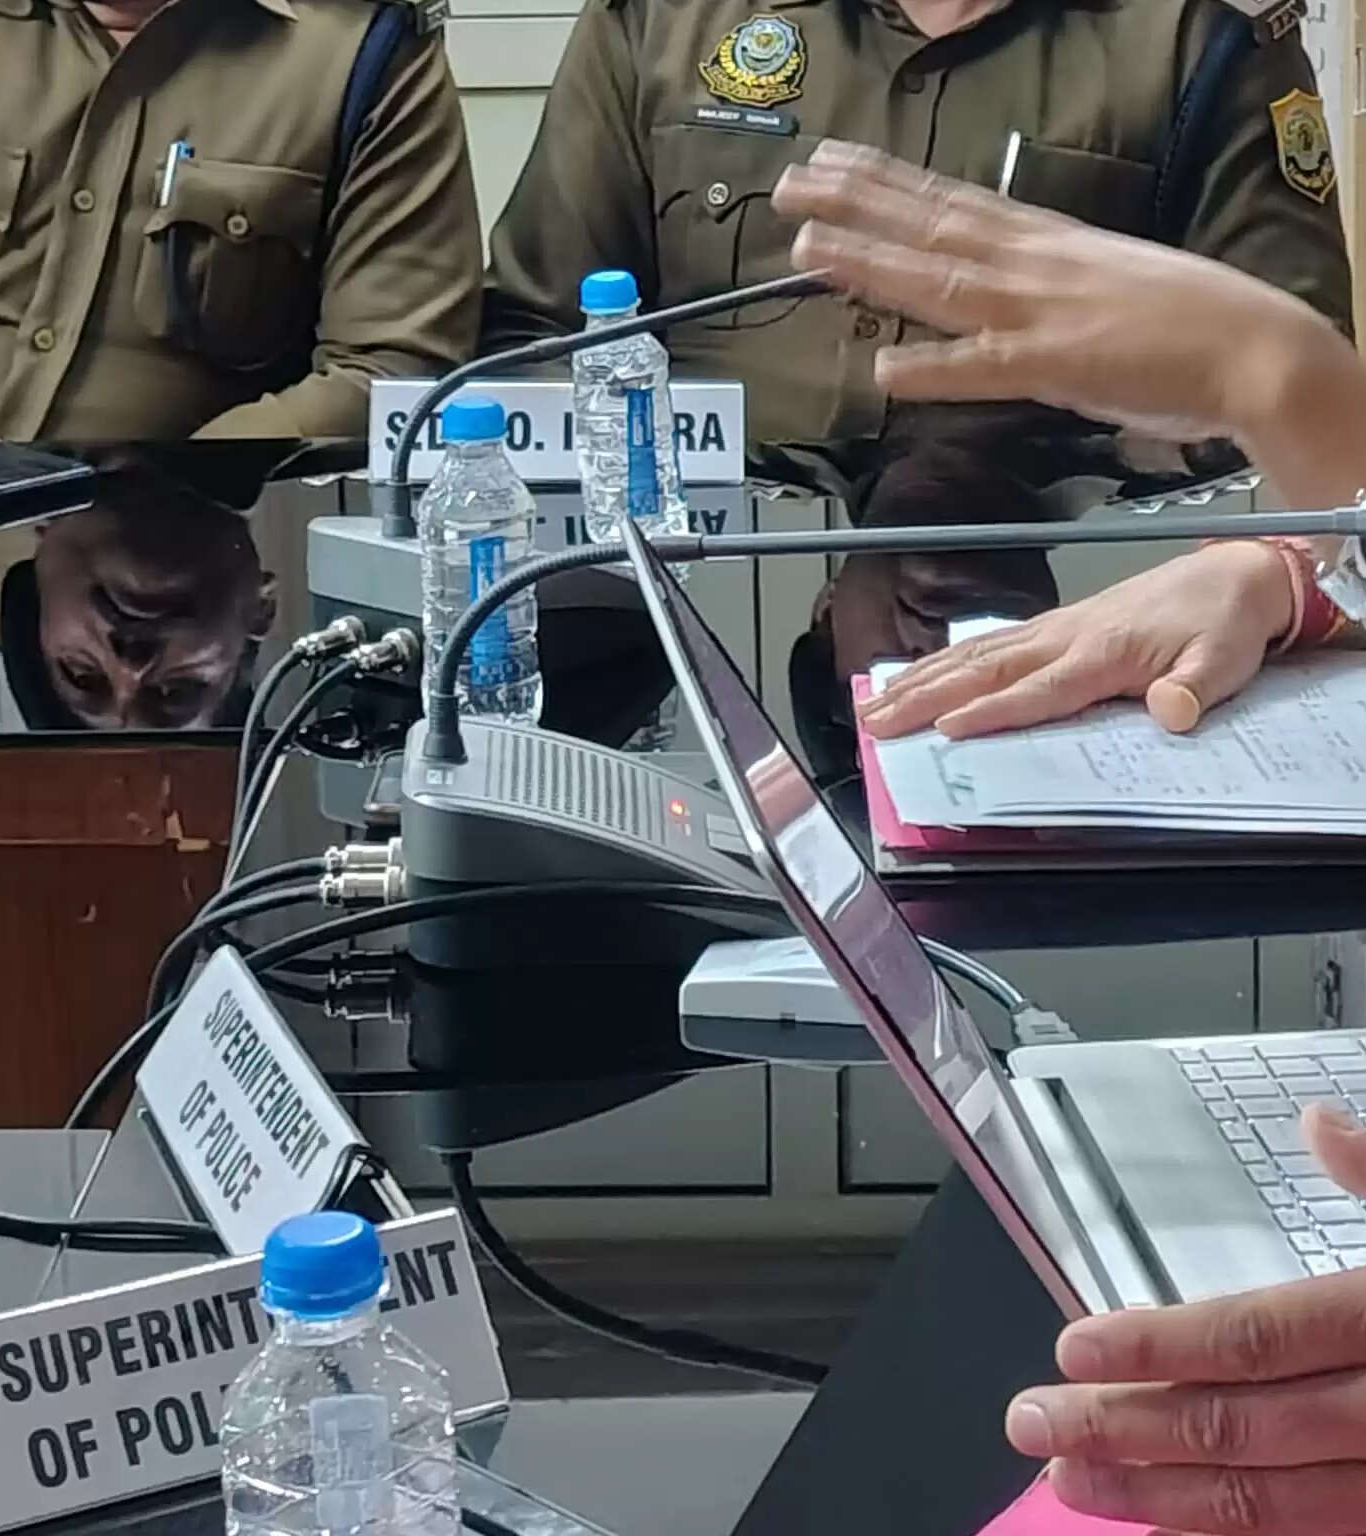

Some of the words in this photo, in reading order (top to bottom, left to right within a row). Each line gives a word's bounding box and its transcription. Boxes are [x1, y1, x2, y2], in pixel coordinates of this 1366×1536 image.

[179, 1079, 217, 1132] OF
[203, 989, 330, 1179] SUPERINTENDENT
[195, 1108, 262, 1212] POLICE
[28, 1418, 98, 1488] OF
[116, 1383, 230, 1467] POL
